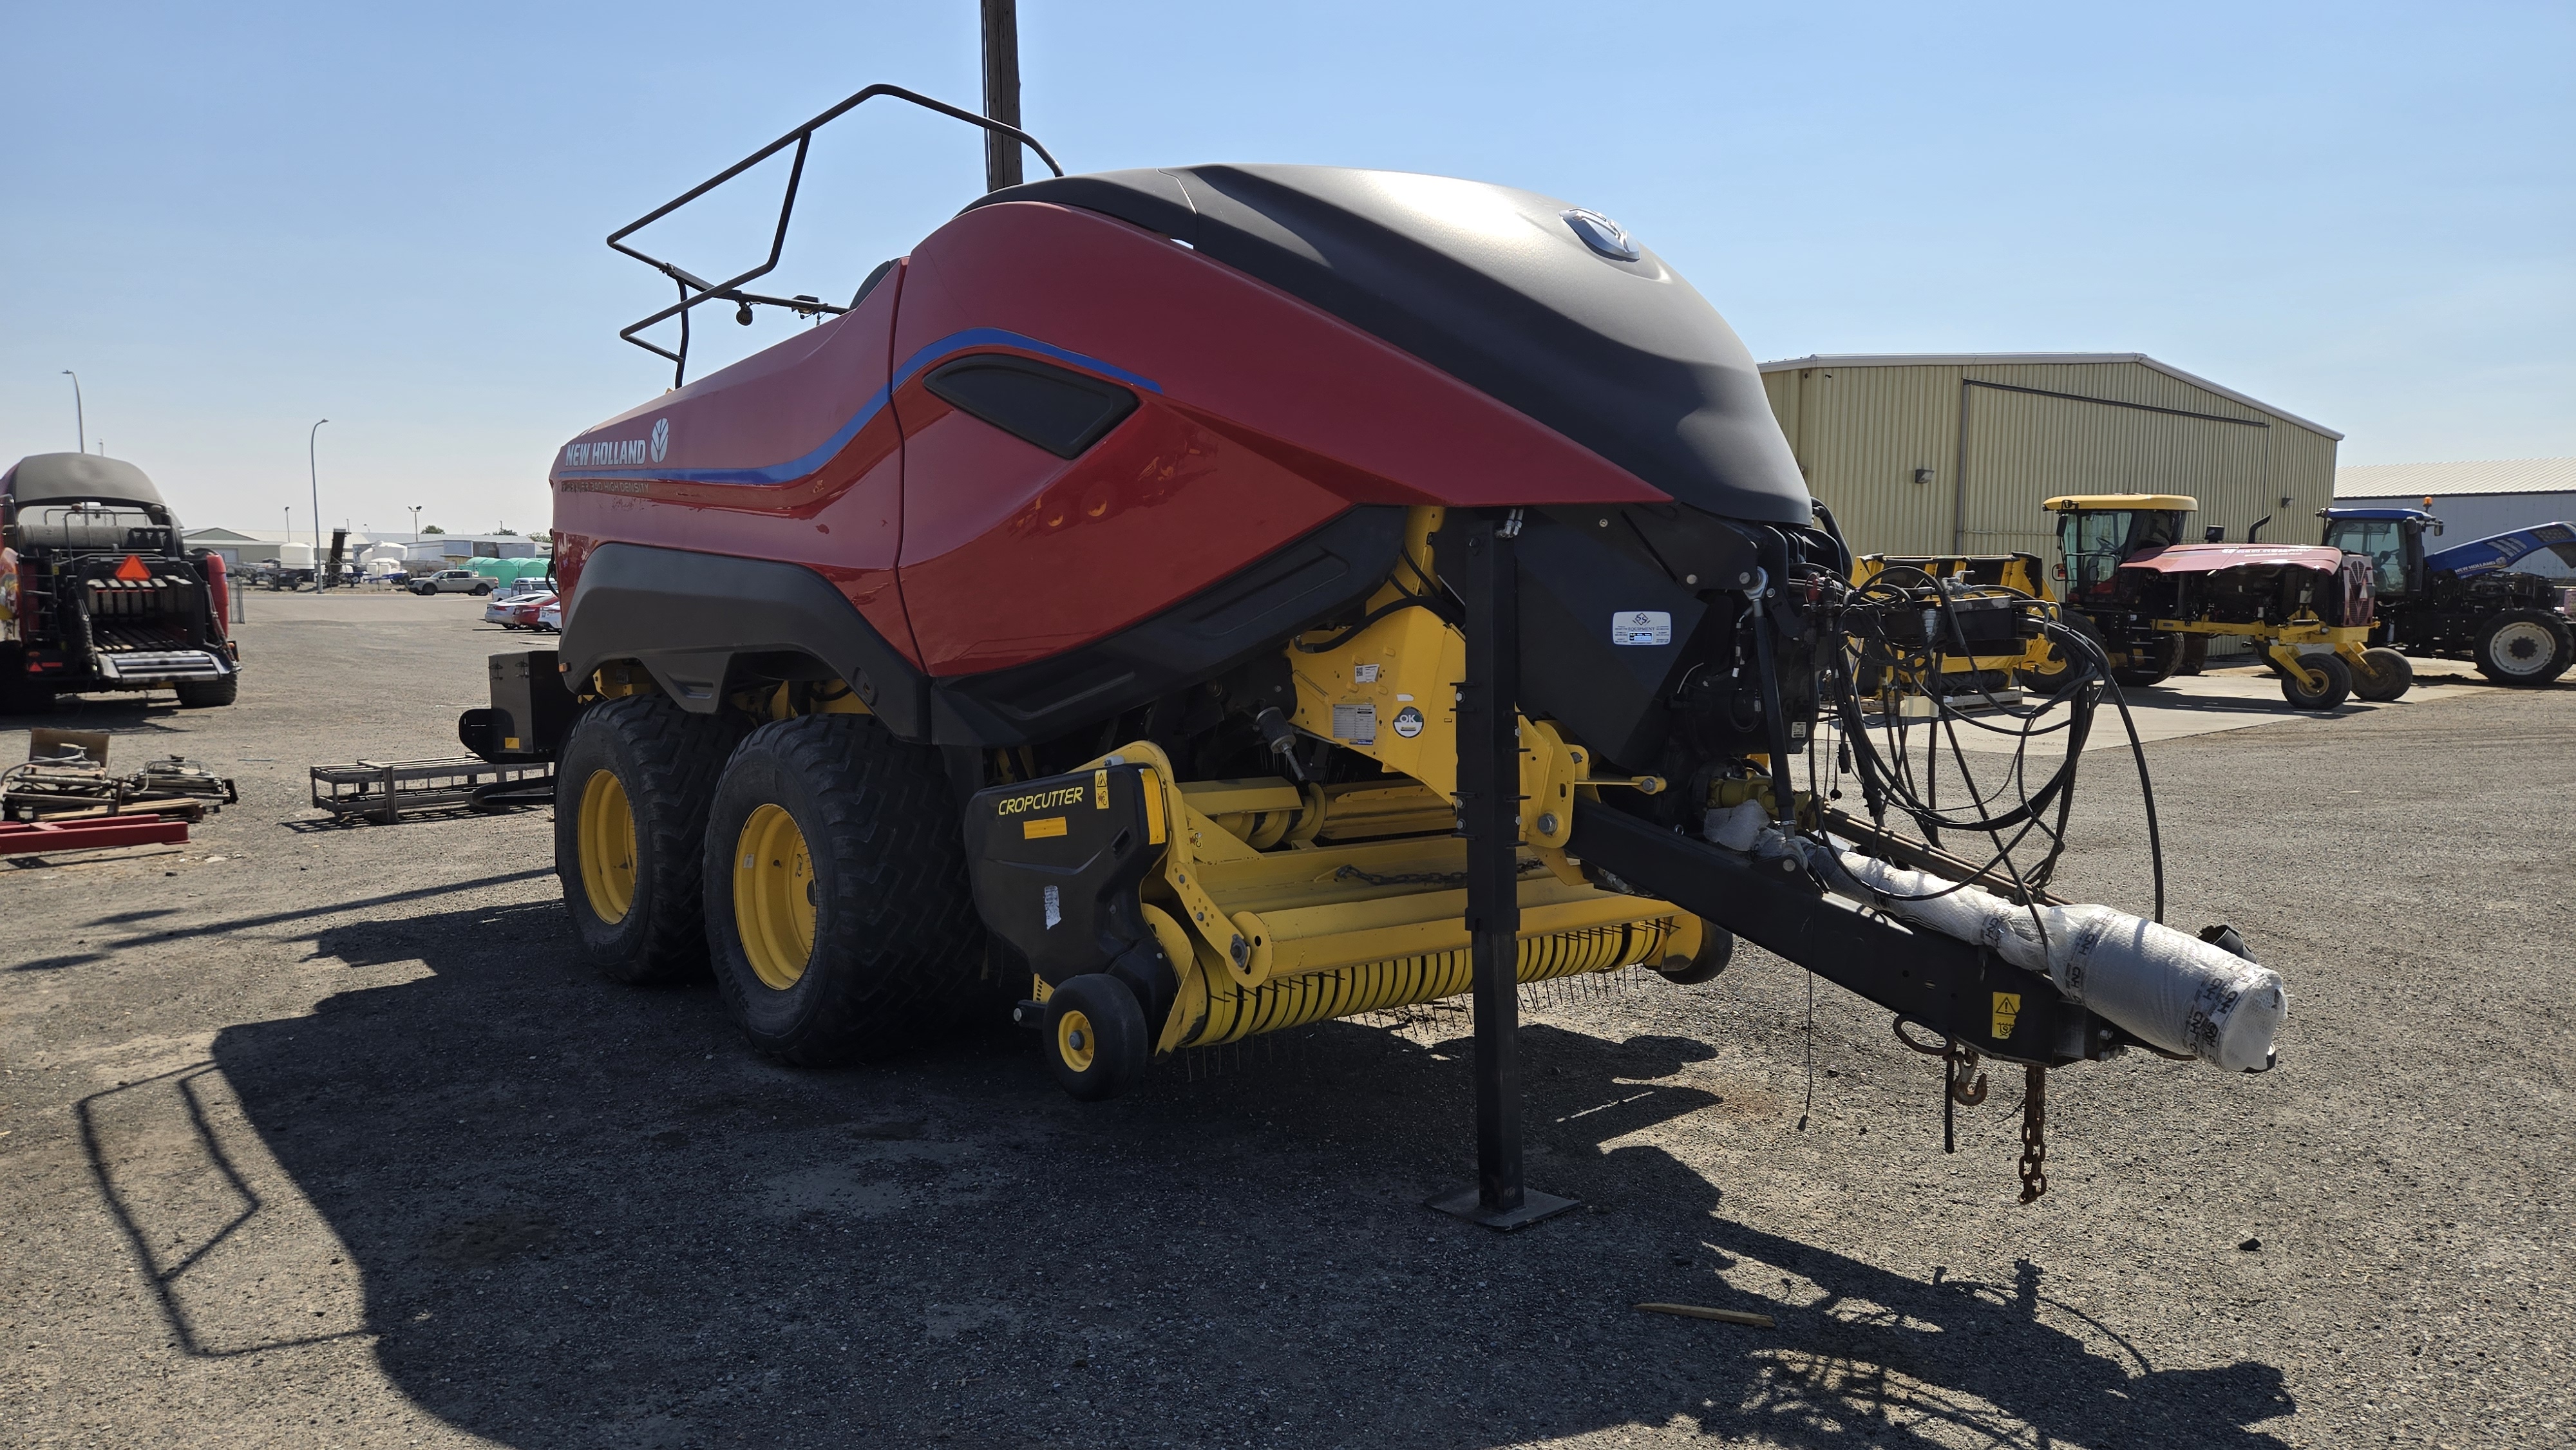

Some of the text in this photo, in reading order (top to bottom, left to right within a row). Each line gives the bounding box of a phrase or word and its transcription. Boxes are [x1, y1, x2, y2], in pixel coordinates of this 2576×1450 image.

[565, 439, 646, 466] NEW HOLLAND
[604, 482, 619, 492] HIGH
[620, 482, 649, 493] DENSITY
[2468, 561, 2496, 570] HOLLAND
[1399, 715, 1417, 723] OK
[998, 786, 1084, 816] CROPCUTTER
[1985, 918, 1999, 939] CNH
[2079, 934, 2096, 956] CNH
[2070, 966, 2081, 989] CNH
[2203, 977, 2223, 1001] CNH
[2217, 991, 2239, 1014] CNH
[2190, 1011, 2203, 1035] CNH
